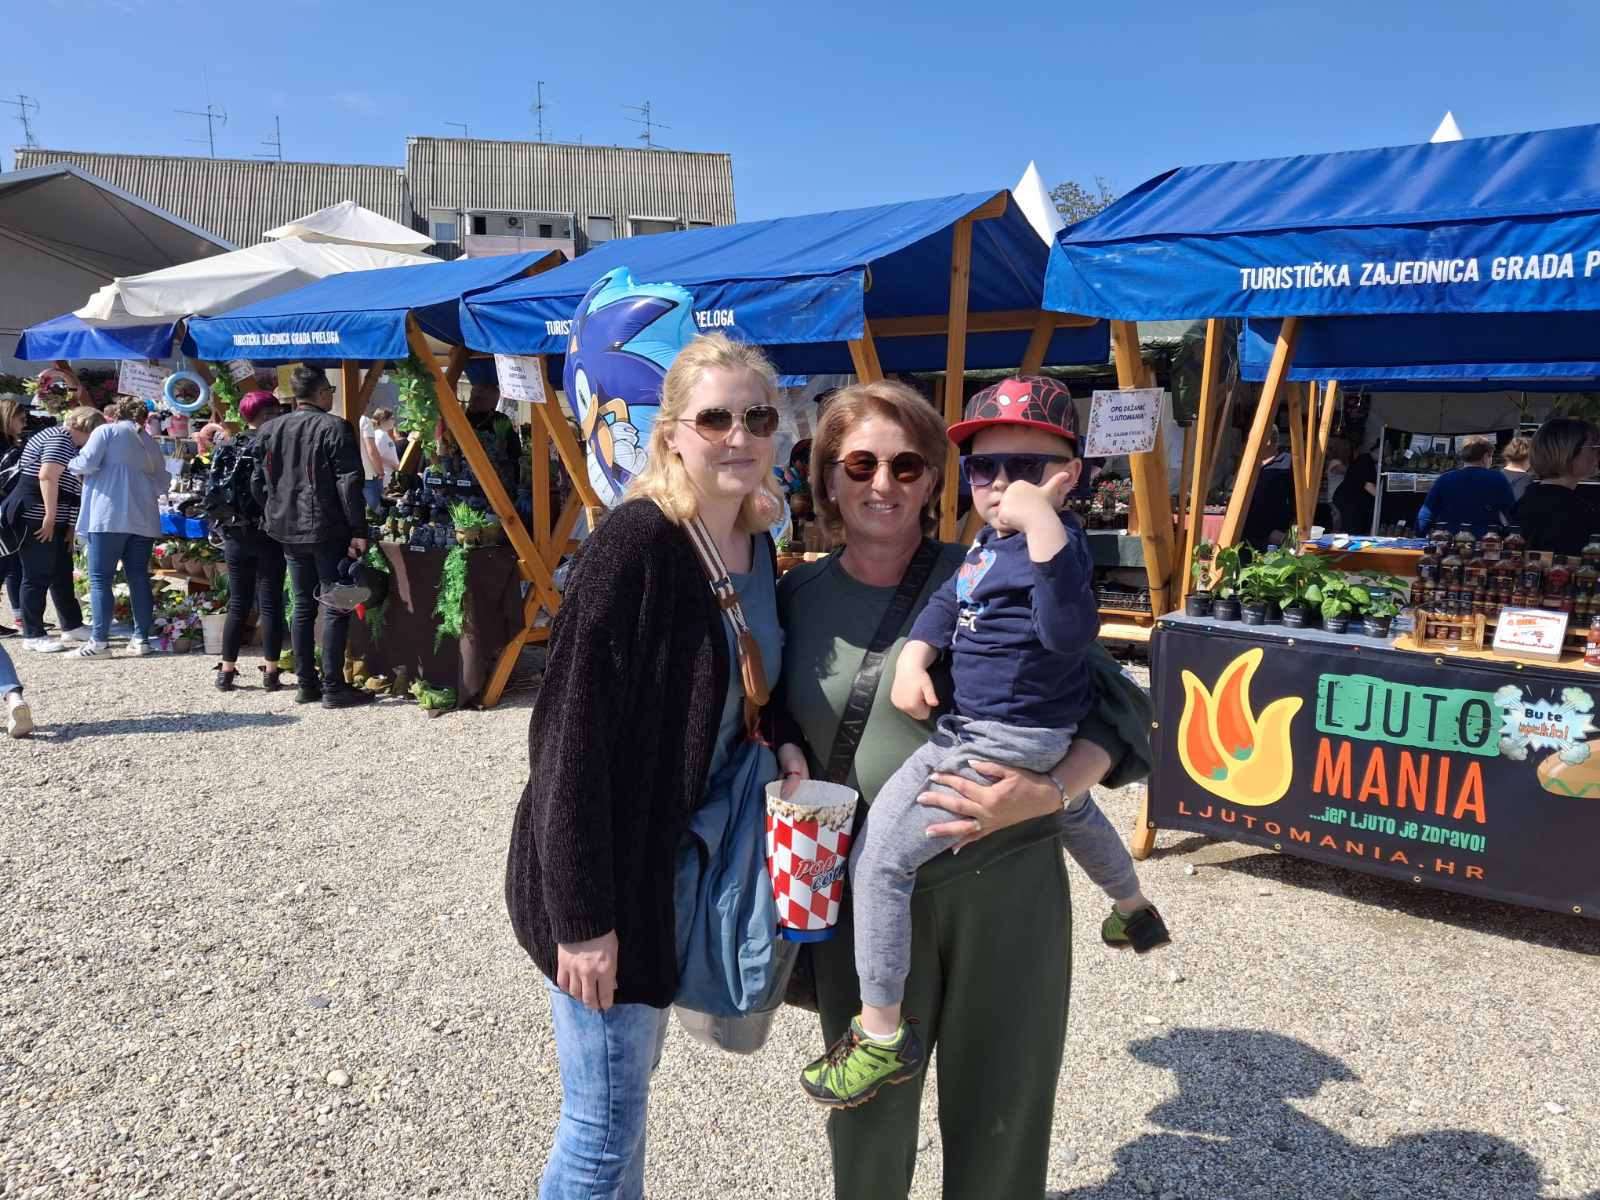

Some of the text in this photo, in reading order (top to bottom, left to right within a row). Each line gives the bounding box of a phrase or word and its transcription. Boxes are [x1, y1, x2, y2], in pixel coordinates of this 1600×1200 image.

[1239, 262, 1350, 290] TURISTIČKA
[1359, 258, 1480, 286] ZAJEDNICA
[1491, 253, 1574, 281] GRADA
[291, 332, 311, 345] GRADA
[312, 331, 339, 344] PRELOGA
[544, 319, 574, 336] TURIST
[1325, 680, 1492, 748] LJUTO
[1525, 708, 1563, 722] Bu te
[1312, 737, 1486, 824] MANIA
[1178, 800, 1486, 881] LJUTOMANIA.HR
[1399, 821, 1418, 839] je
[793, 854, 837, 881] Pop
